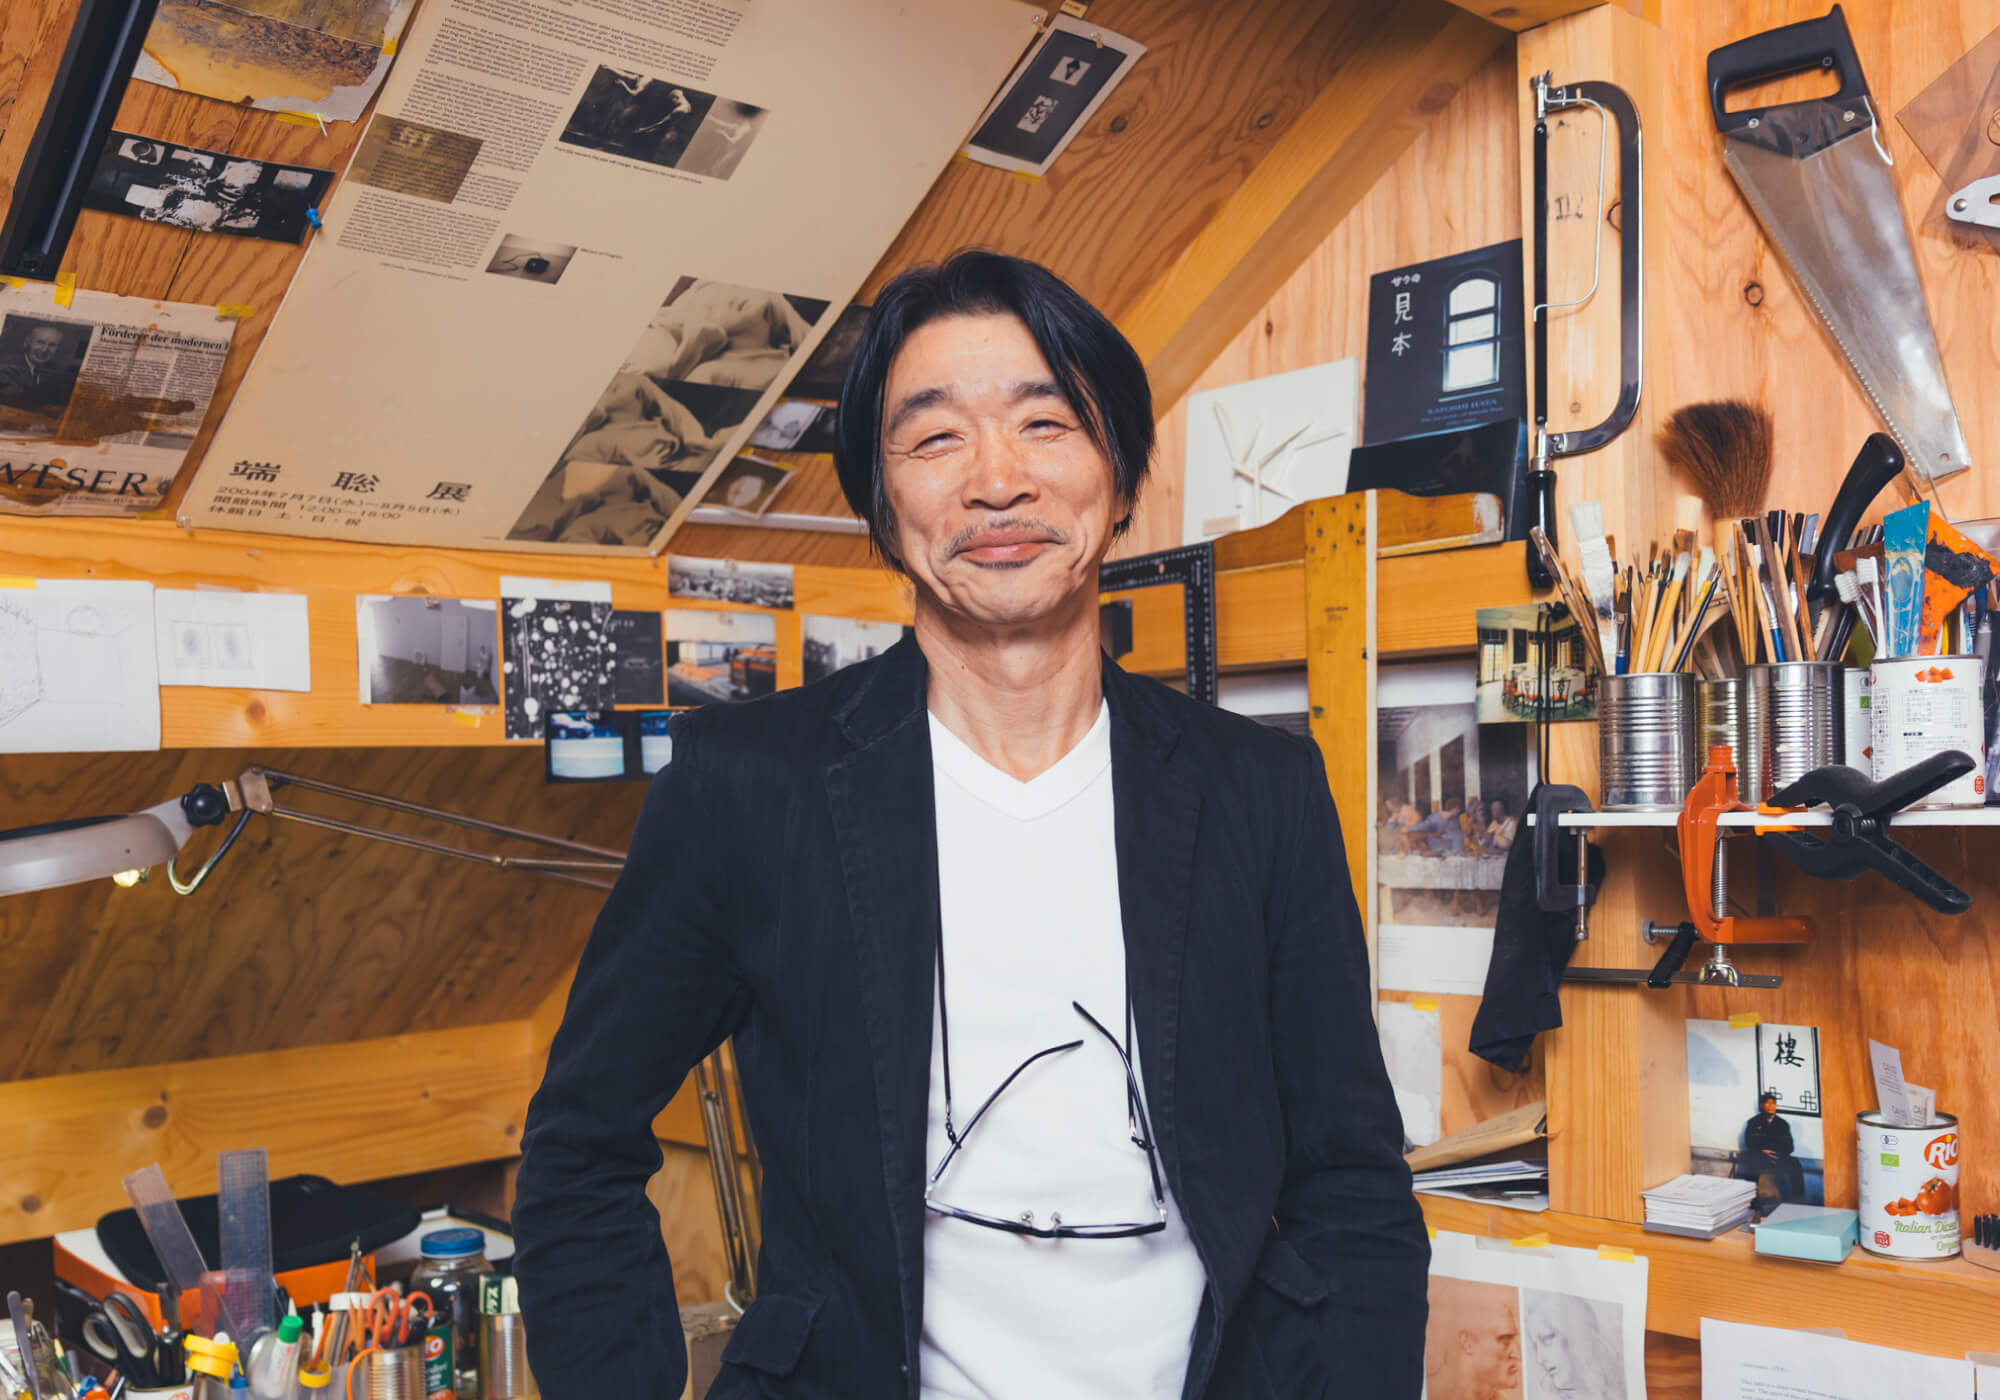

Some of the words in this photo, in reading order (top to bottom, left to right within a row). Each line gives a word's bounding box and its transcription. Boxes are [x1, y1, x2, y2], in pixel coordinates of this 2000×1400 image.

[101, 327, 149, 341] Förderer
[150, 333, 168, 342] der
[170, 336, 221, 349] modernen
[1391, 292, 1414, 357] 見本
